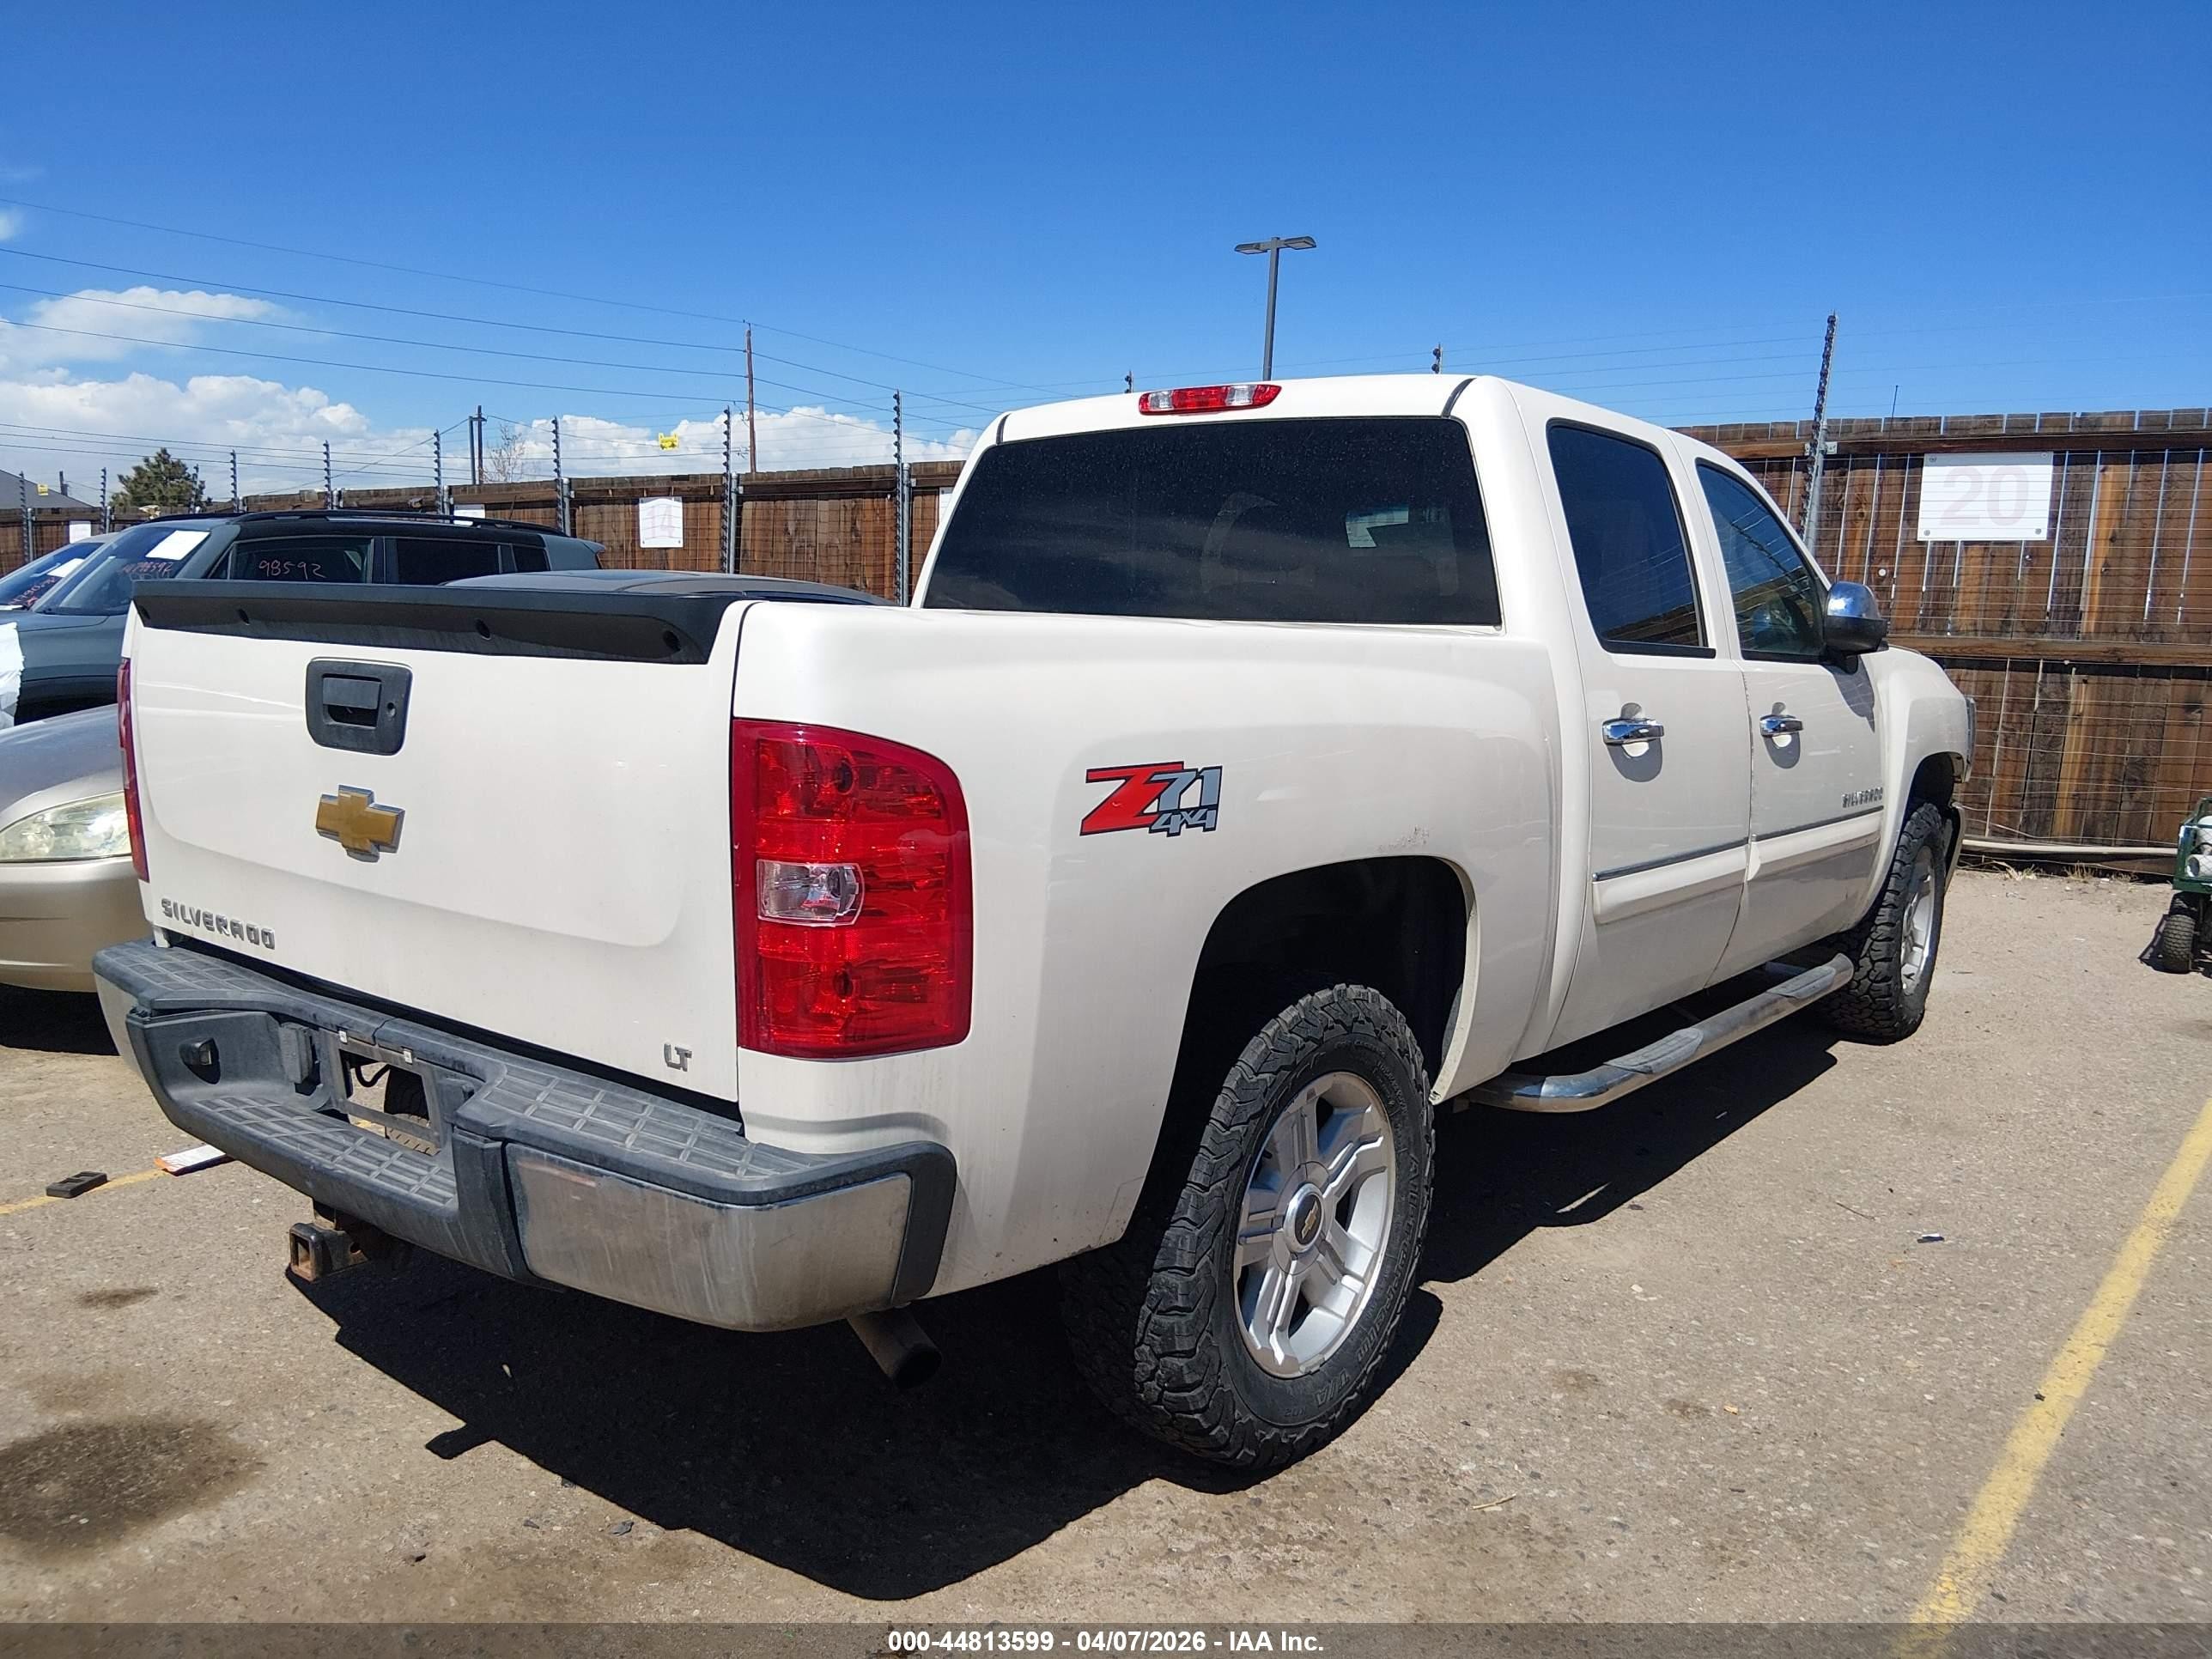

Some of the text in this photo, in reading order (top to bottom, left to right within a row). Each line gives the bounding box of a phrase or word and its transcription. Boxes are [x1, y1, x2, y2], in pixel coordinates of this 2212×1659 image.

[1939, 465, 2029, 526] 20
[646, 505, 677, 538] 14
[258, 559, 326, 580] 98592
[1079, 761, 1223, 836] Z71
[161, 898, 275, 950] SILVERADO
[663, 1043, 692, 1073] LT
